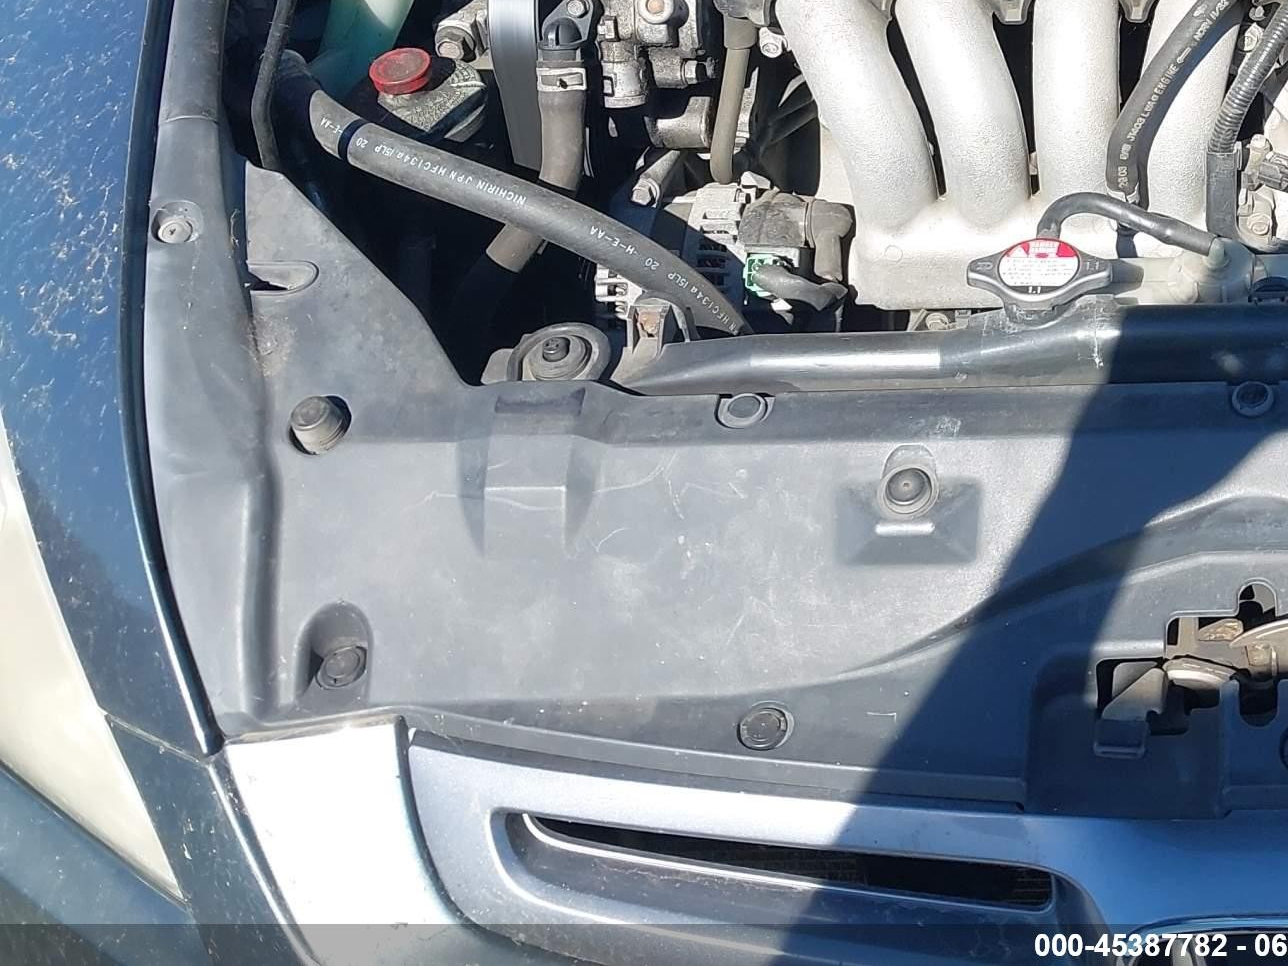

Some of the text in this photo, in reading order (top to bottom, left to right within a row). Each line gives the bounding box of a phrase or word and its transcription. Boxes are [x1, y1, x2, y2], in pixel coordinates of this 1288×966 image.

[355, 137, 369, 148] 20
[448, 169, 473, 184] JPN
[475, 180, 527, 205] NICHIRIN
[644, 257, 660, 271] 20
[1028, 285, 1042, 294] 1.1
